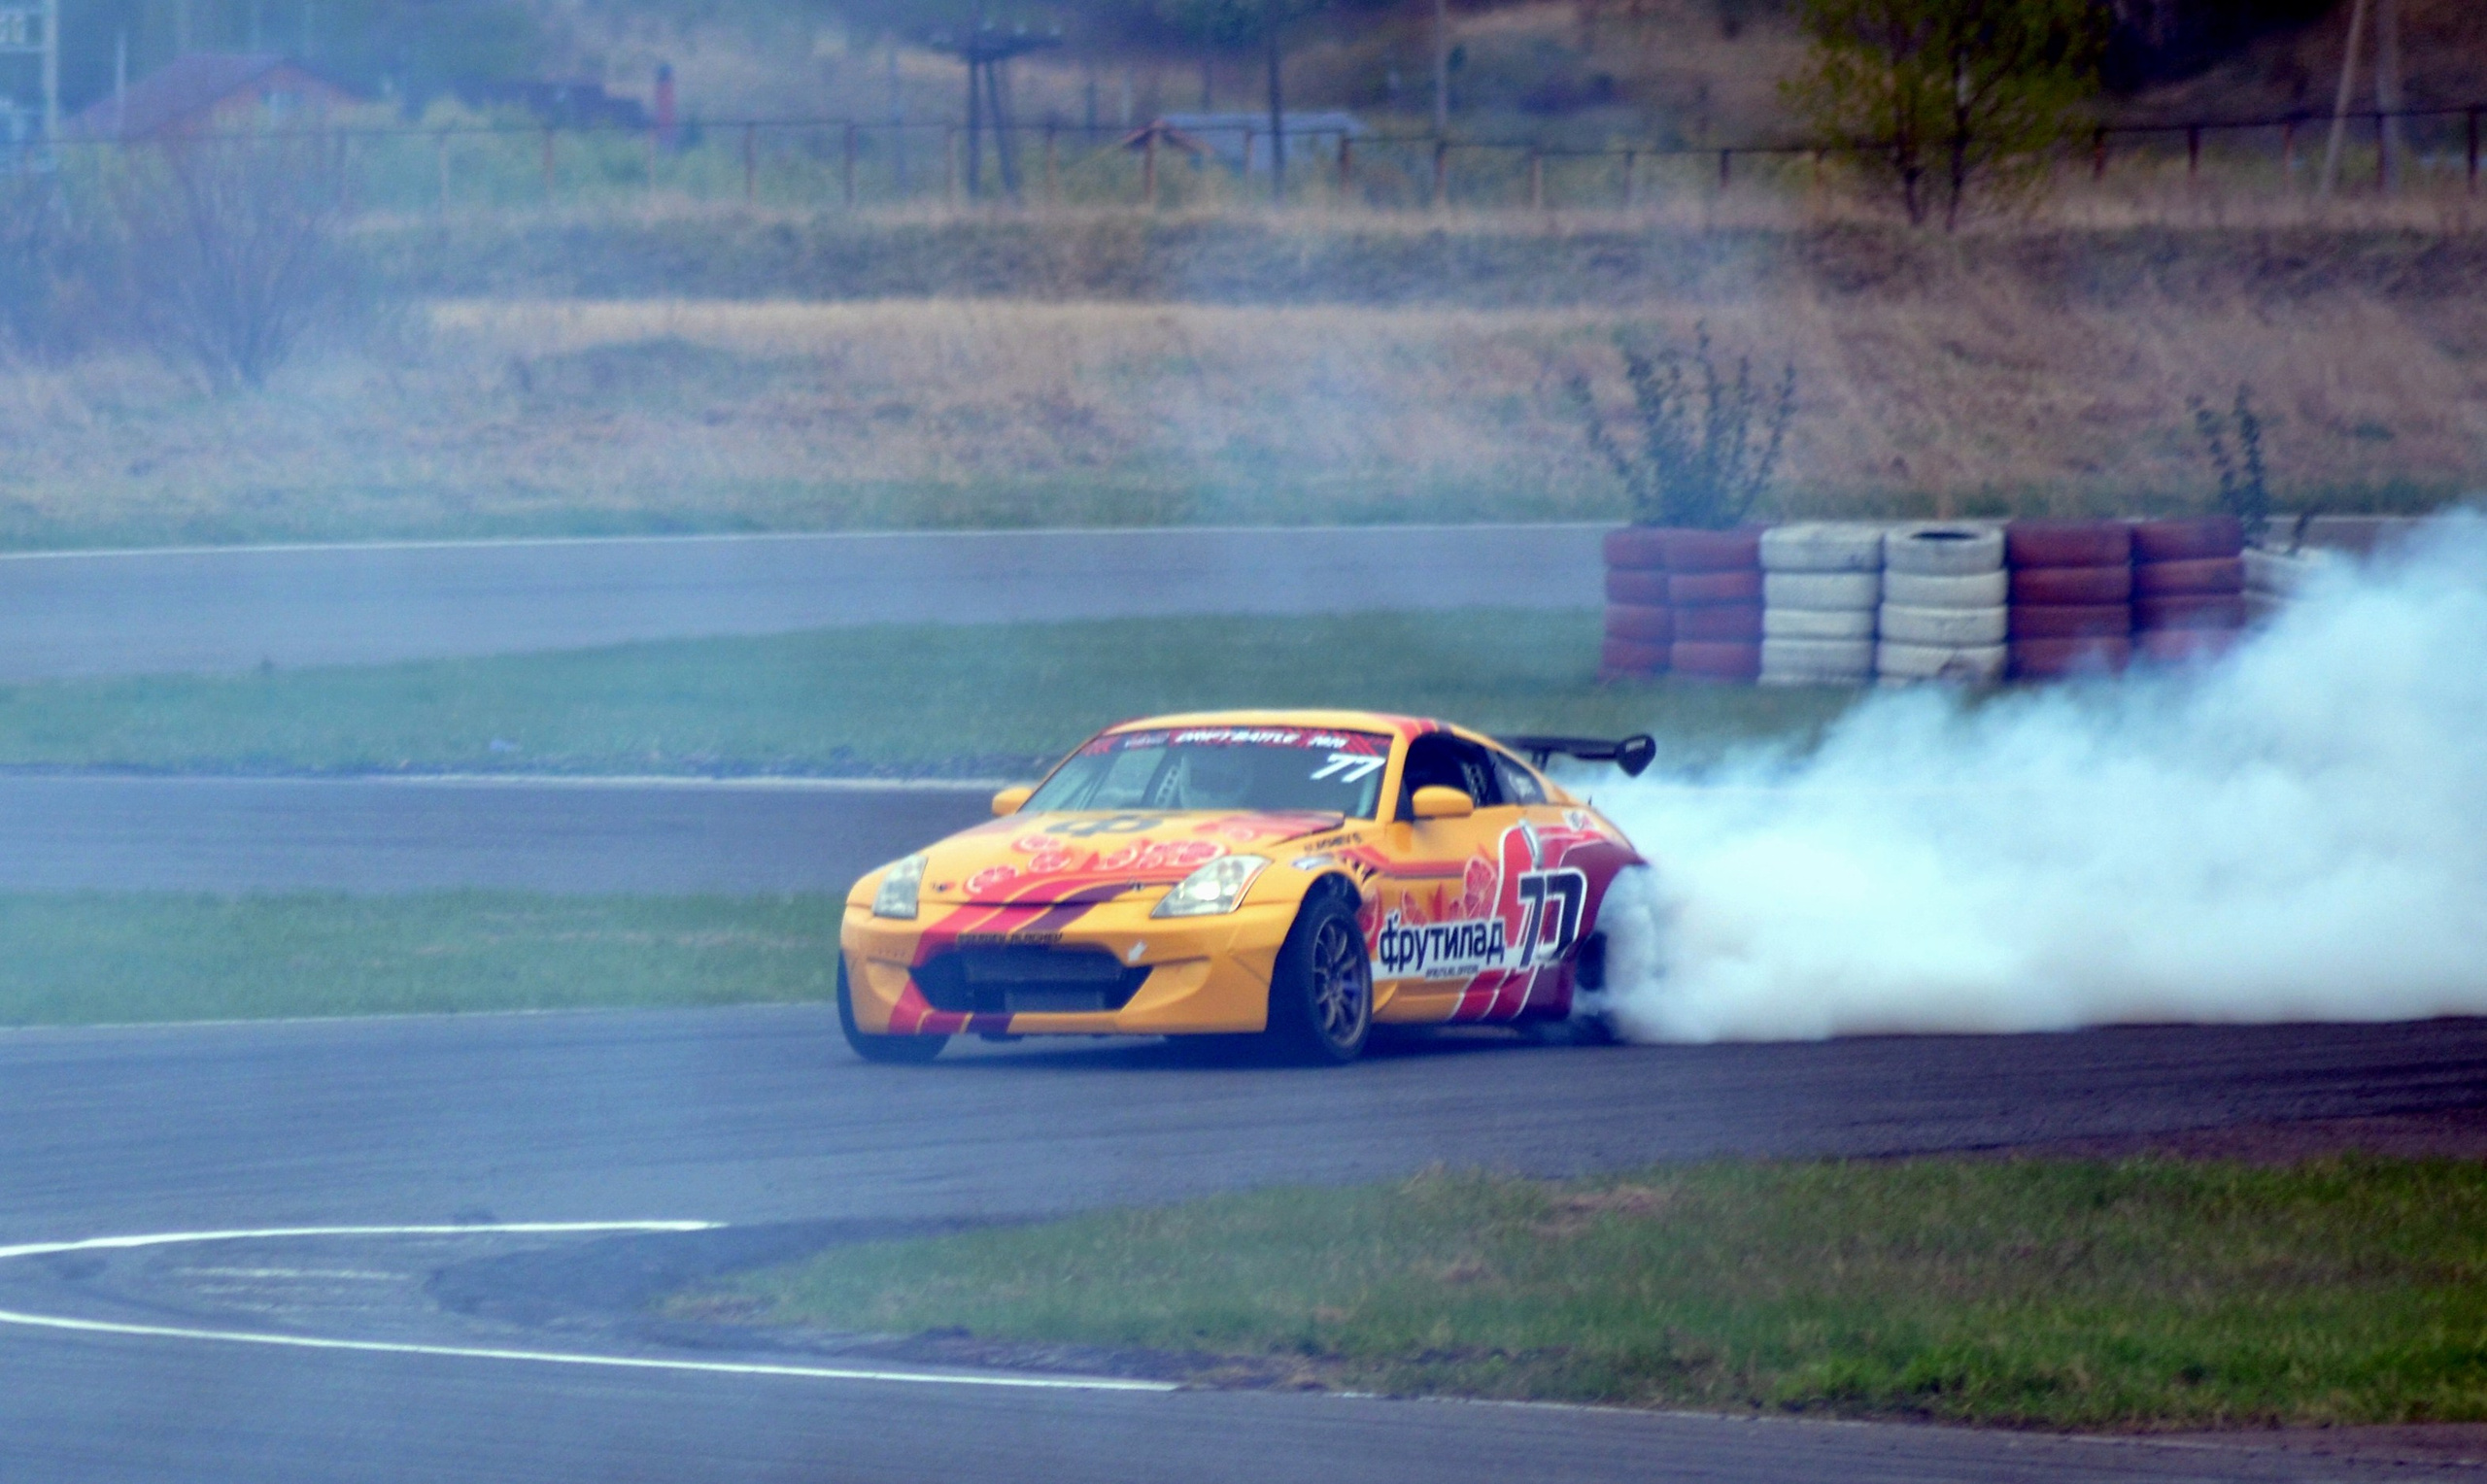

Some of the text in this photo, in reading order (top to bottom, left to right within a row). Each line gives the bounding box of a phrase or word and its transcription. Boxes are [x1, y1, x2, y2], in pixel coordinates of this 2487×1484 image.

[1311, 754, 1386, 784] 77
[1380, 910, 1506, 972] фрутилад
[1518, 869, 1586, 970] 77
